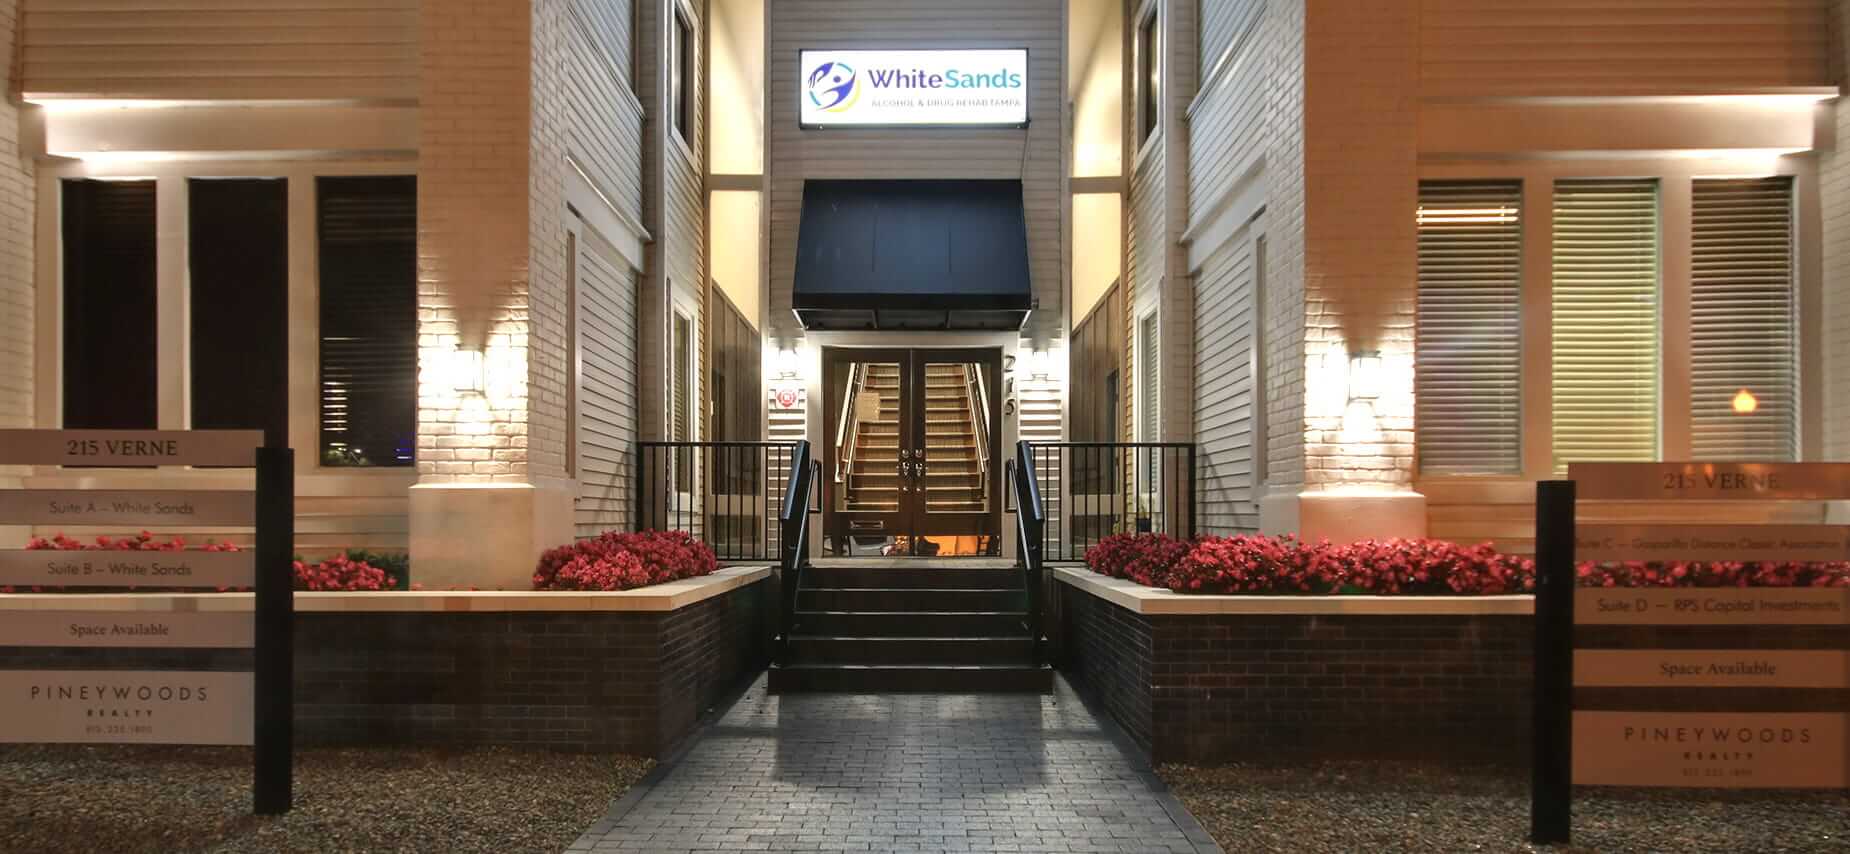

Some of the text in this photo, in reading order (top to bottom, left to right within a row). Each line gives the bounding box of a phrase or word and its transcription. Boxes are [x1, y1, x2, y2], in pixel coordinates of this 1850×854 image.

[871, 96, 914, 107] ALCOHOL
[927, 96, 954, 107] DRUG
[990, 96, 1021, 107] TAMPA
[67, 440, 177, 456] 215 VERNE
[1663, 472, 1780, 490] 215 VERNE
[49, 500, 81, 514] Suite
[86, 502, 97, 513] A
[112, 501, 151, 514] White
[154, 501, 194, 515] Sands
[47, 562, 80, 576] Suite
[84, 562, 92, 575] B
[108, 562, 148, 576] White
[152, 562, 192, 576] Sands
[1597, 599, 1631, 613] Suite
[1636, 599, 1648, 612] D
[1674, 599, 1698, 613] RPS
[1703, 598, 1754, 615] Capital
[70, 623, 169, 638] Space Available
[1660, 661, 1776, 677] Space Available
[31, 686, 208, 701] PINEYWOODS
[87, 709, 153, 718] REALTY
[1624, 726, 1811, 744] PINEYWOODS
